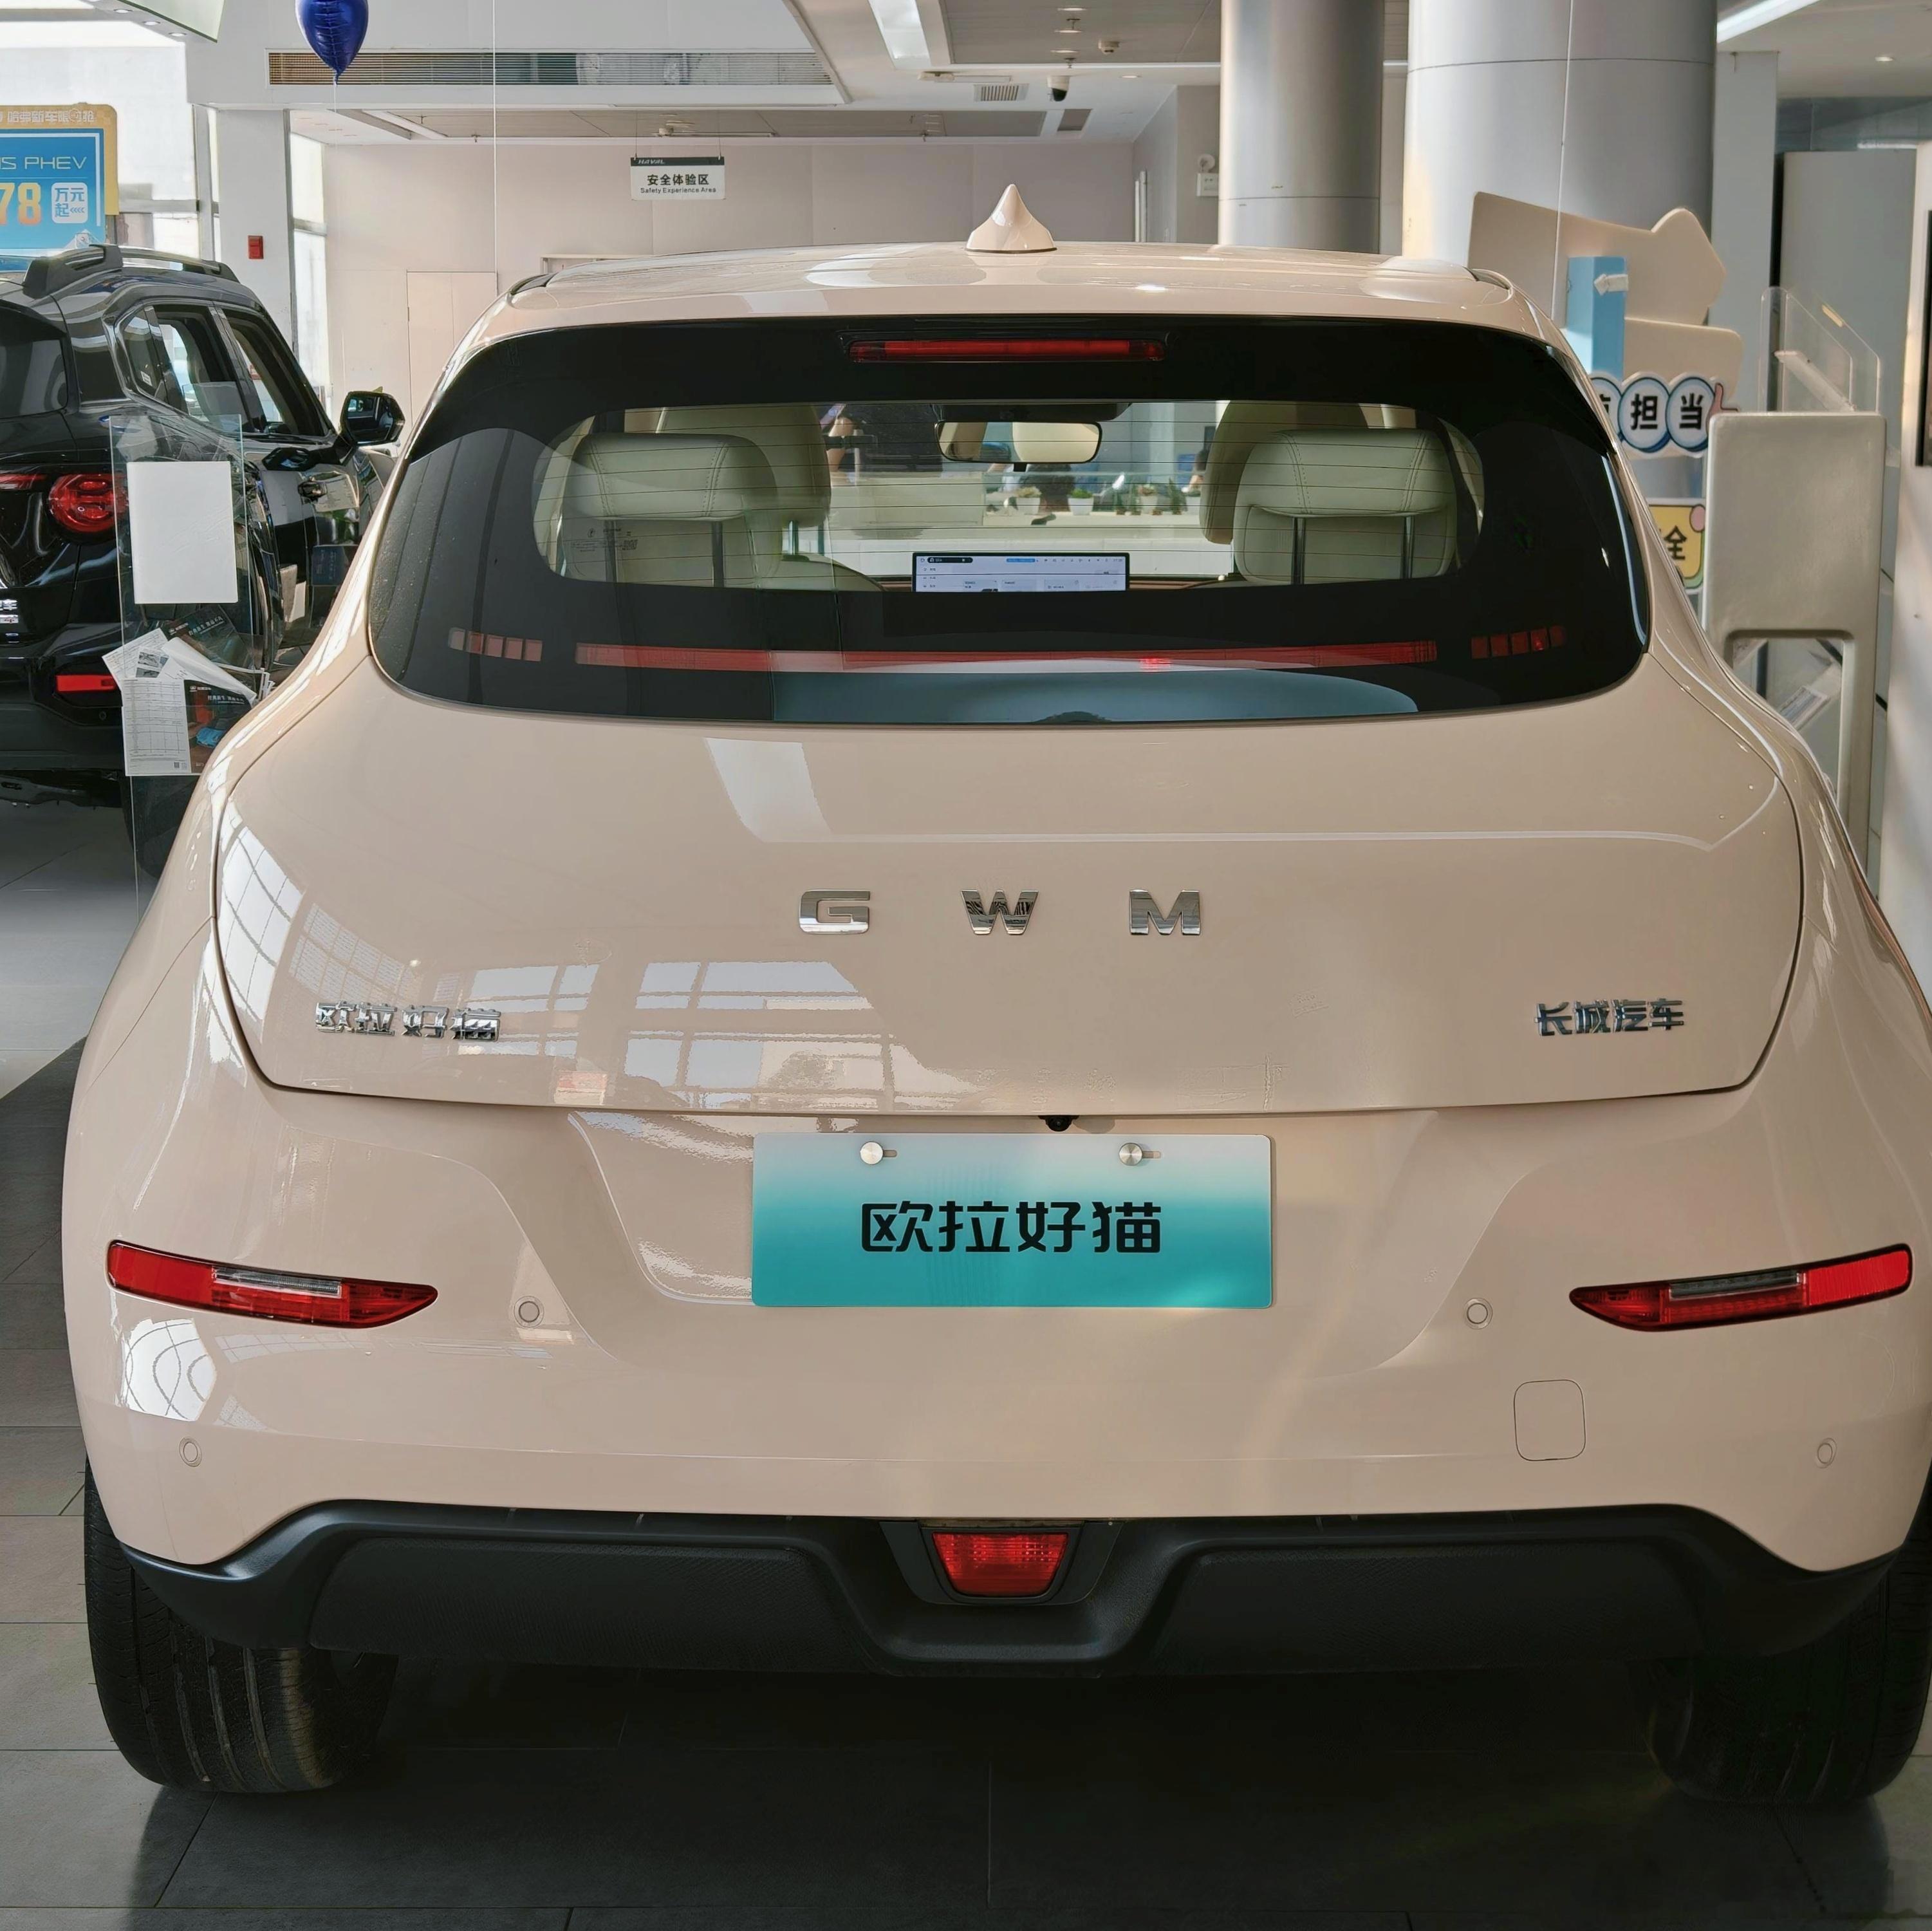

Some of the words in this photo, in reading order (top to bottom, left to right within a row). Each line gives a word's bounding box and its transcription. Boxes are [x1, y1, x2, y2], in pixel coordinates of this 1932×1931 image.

[24, 156, 87, 169] PHEV
[647, 174, 709, 186] 安全体验区
[55, 187, 85, 202] 万元
[55, 203, 70, 218] 起
[1658, 525, 1687, 560] 全
[799, 890, 1202, 935] GWM
[1534, 998, 1684, 1036] 长城汽车
[861, 1200, 1162, 1254] 欧拉好猫
